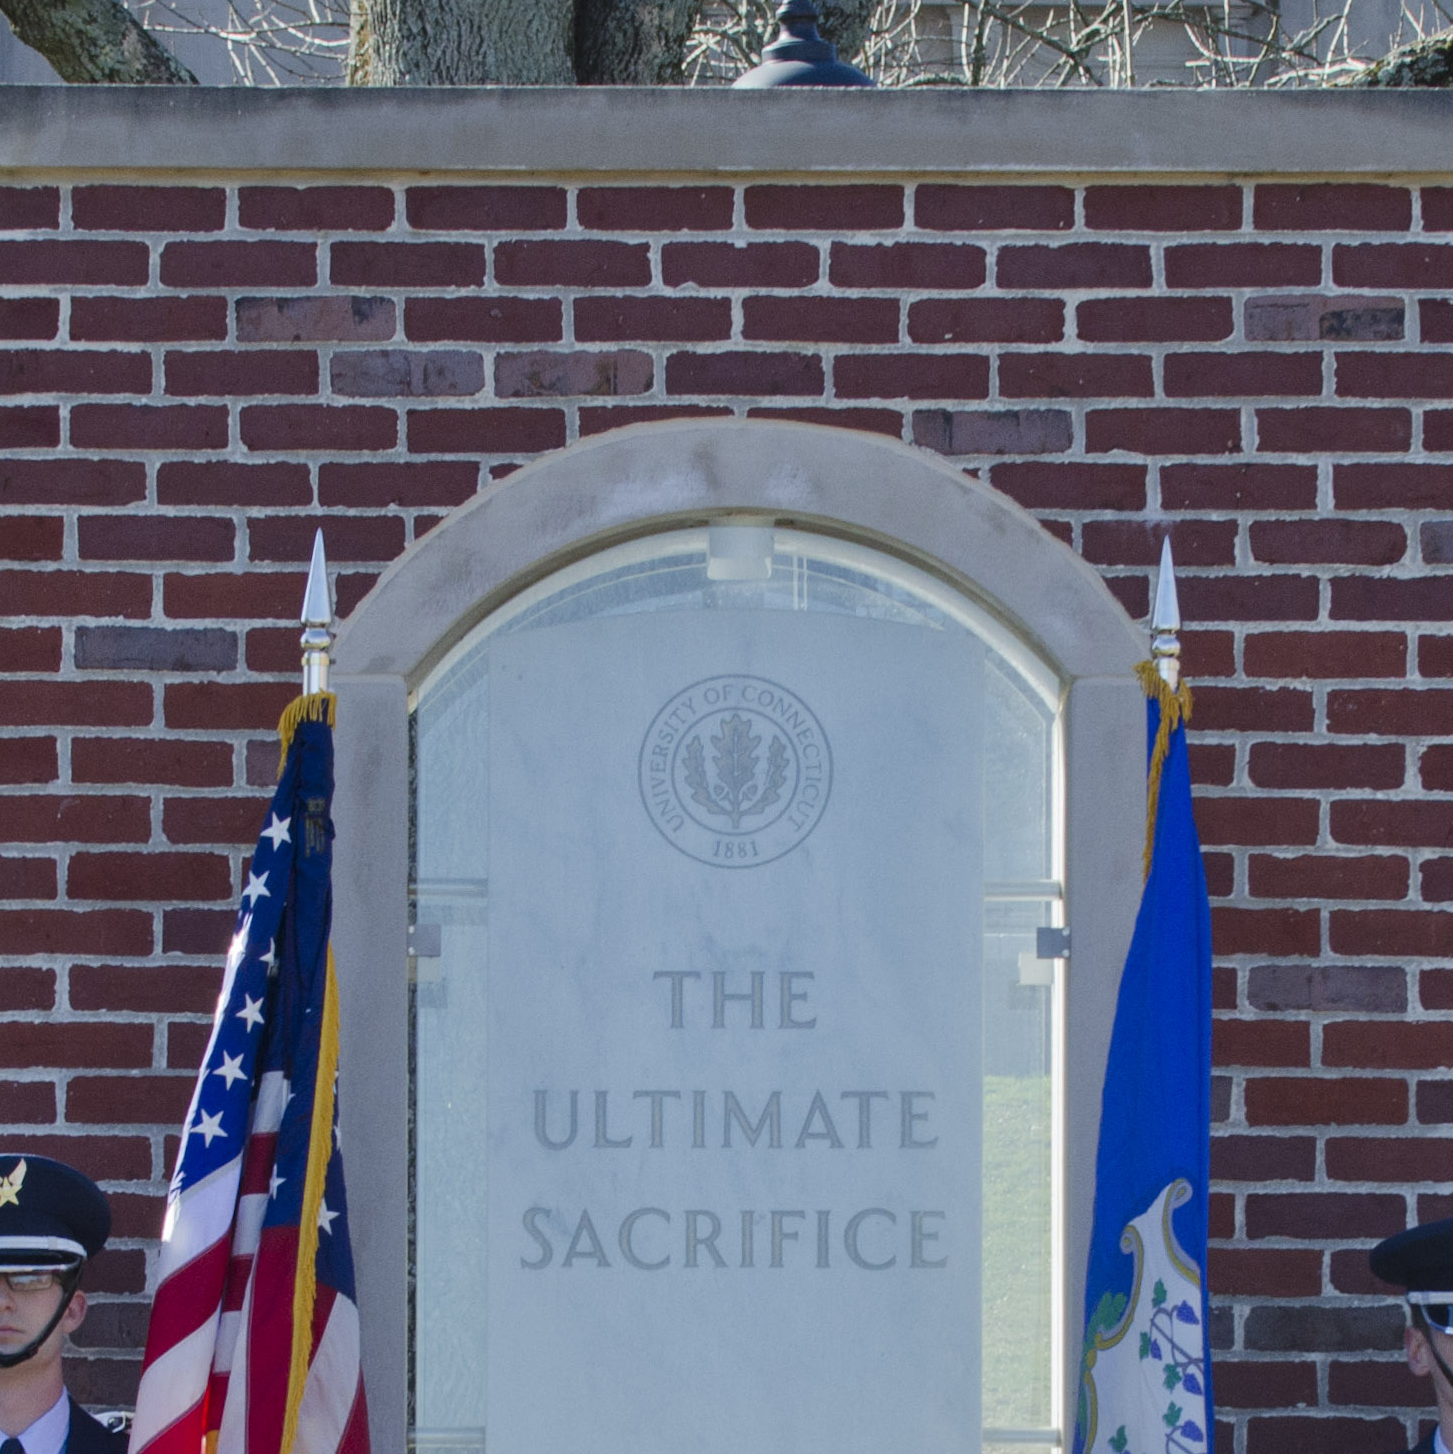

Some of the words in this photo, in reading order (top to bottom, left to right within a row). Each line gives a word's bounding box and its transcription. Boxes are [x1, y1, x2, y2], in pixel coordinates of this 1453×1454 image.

[650, 697, 697, 833] UNIVERSITY
[704, 684, 734, 704] OF
[742, 685, 822, 833] CONNECTICUT
[713, 840, 758, 859] 1881
[652, 970, 817, 1029] THE
[533, 1089, 939, 1151] ULTIMATE
[520, 1207, 948, 1270] SACRIFICE
